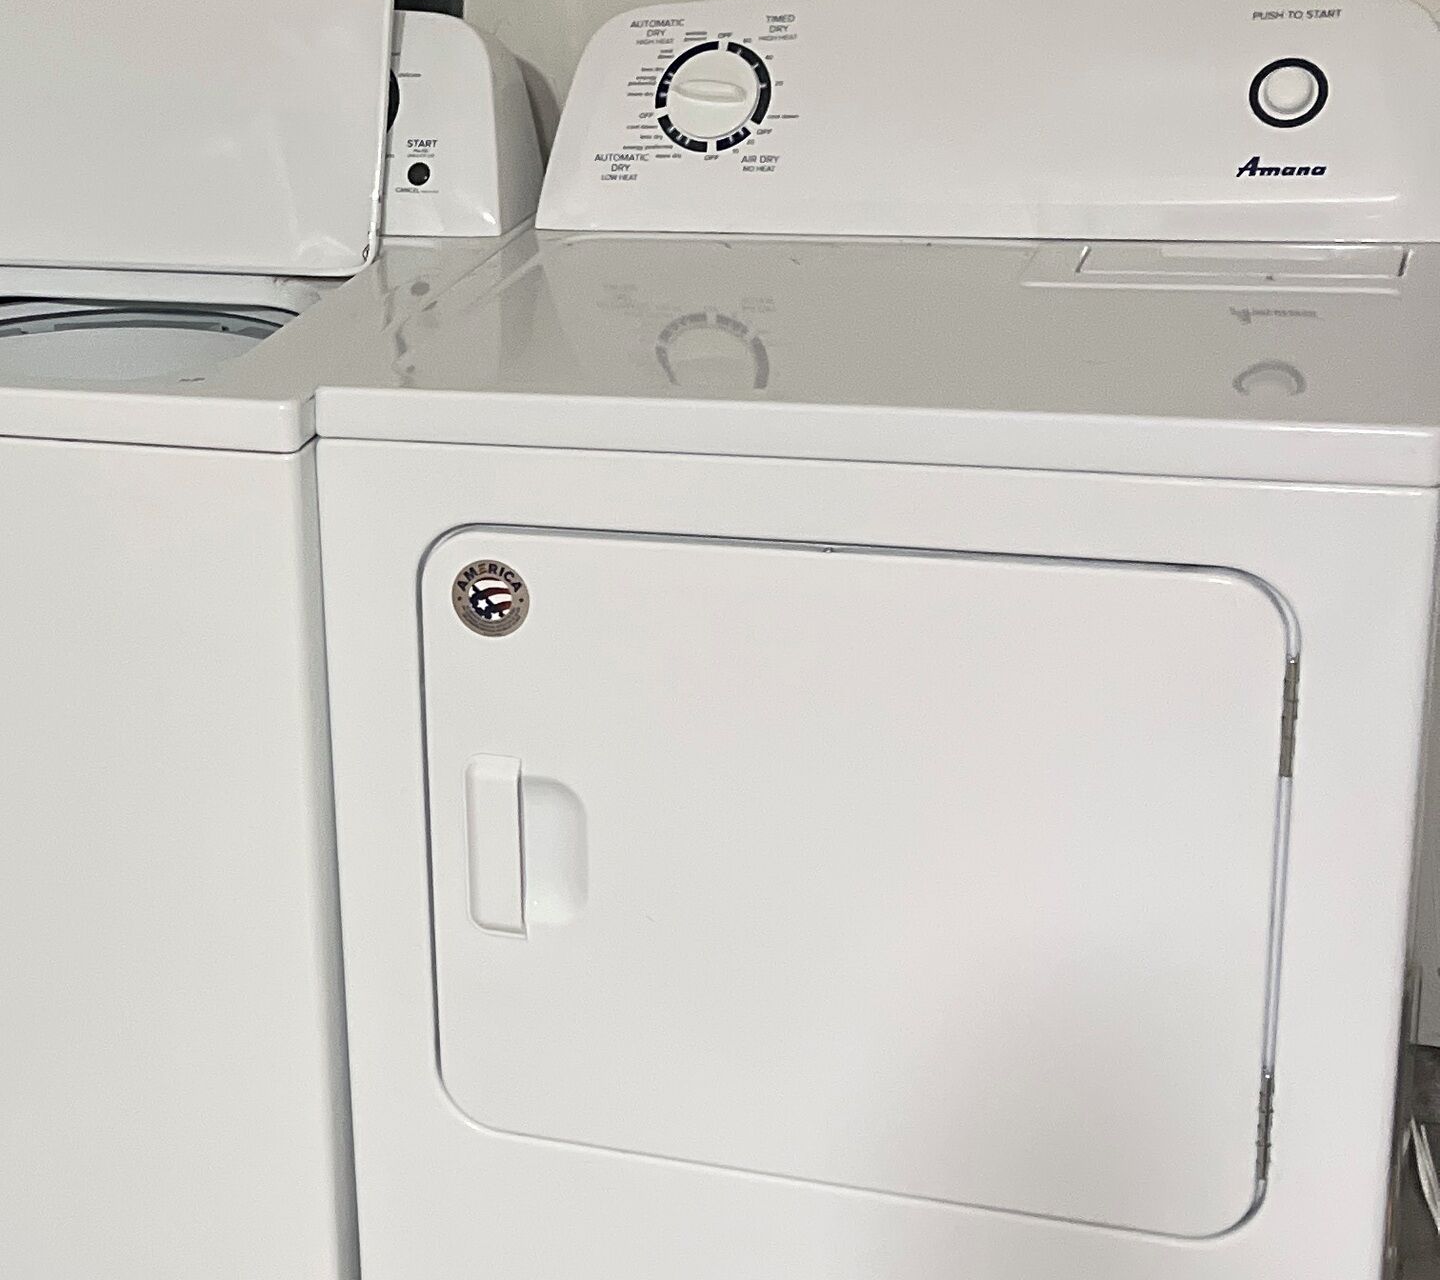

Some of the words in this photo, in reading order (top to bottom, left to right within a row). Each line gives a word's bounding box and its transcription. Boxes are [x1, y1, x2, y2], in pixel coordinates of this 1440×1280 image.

[765, 14, 796, 23] TIMED
[1252, 9, 1285, 21] PUSH
[1288, 9, 1303, 20] TO
[1305, 8, 1342, 20] START
[630, 19, 685, 28] AUTOMATIC
[647, 29, 667, 37] DRY
[769, 25, 790, 33] DRY
[407, 139, 438, 148] START
[594, 153, 650, 162] AUTOMATIC
[741, 155, 757, 164] AIR
[759, 155, 780, 164] DRY
[611, 164, 631, 172] DRY
[1236, 156, 1327, 178] Amana
[457, 563, 522, 593] AMERICA
